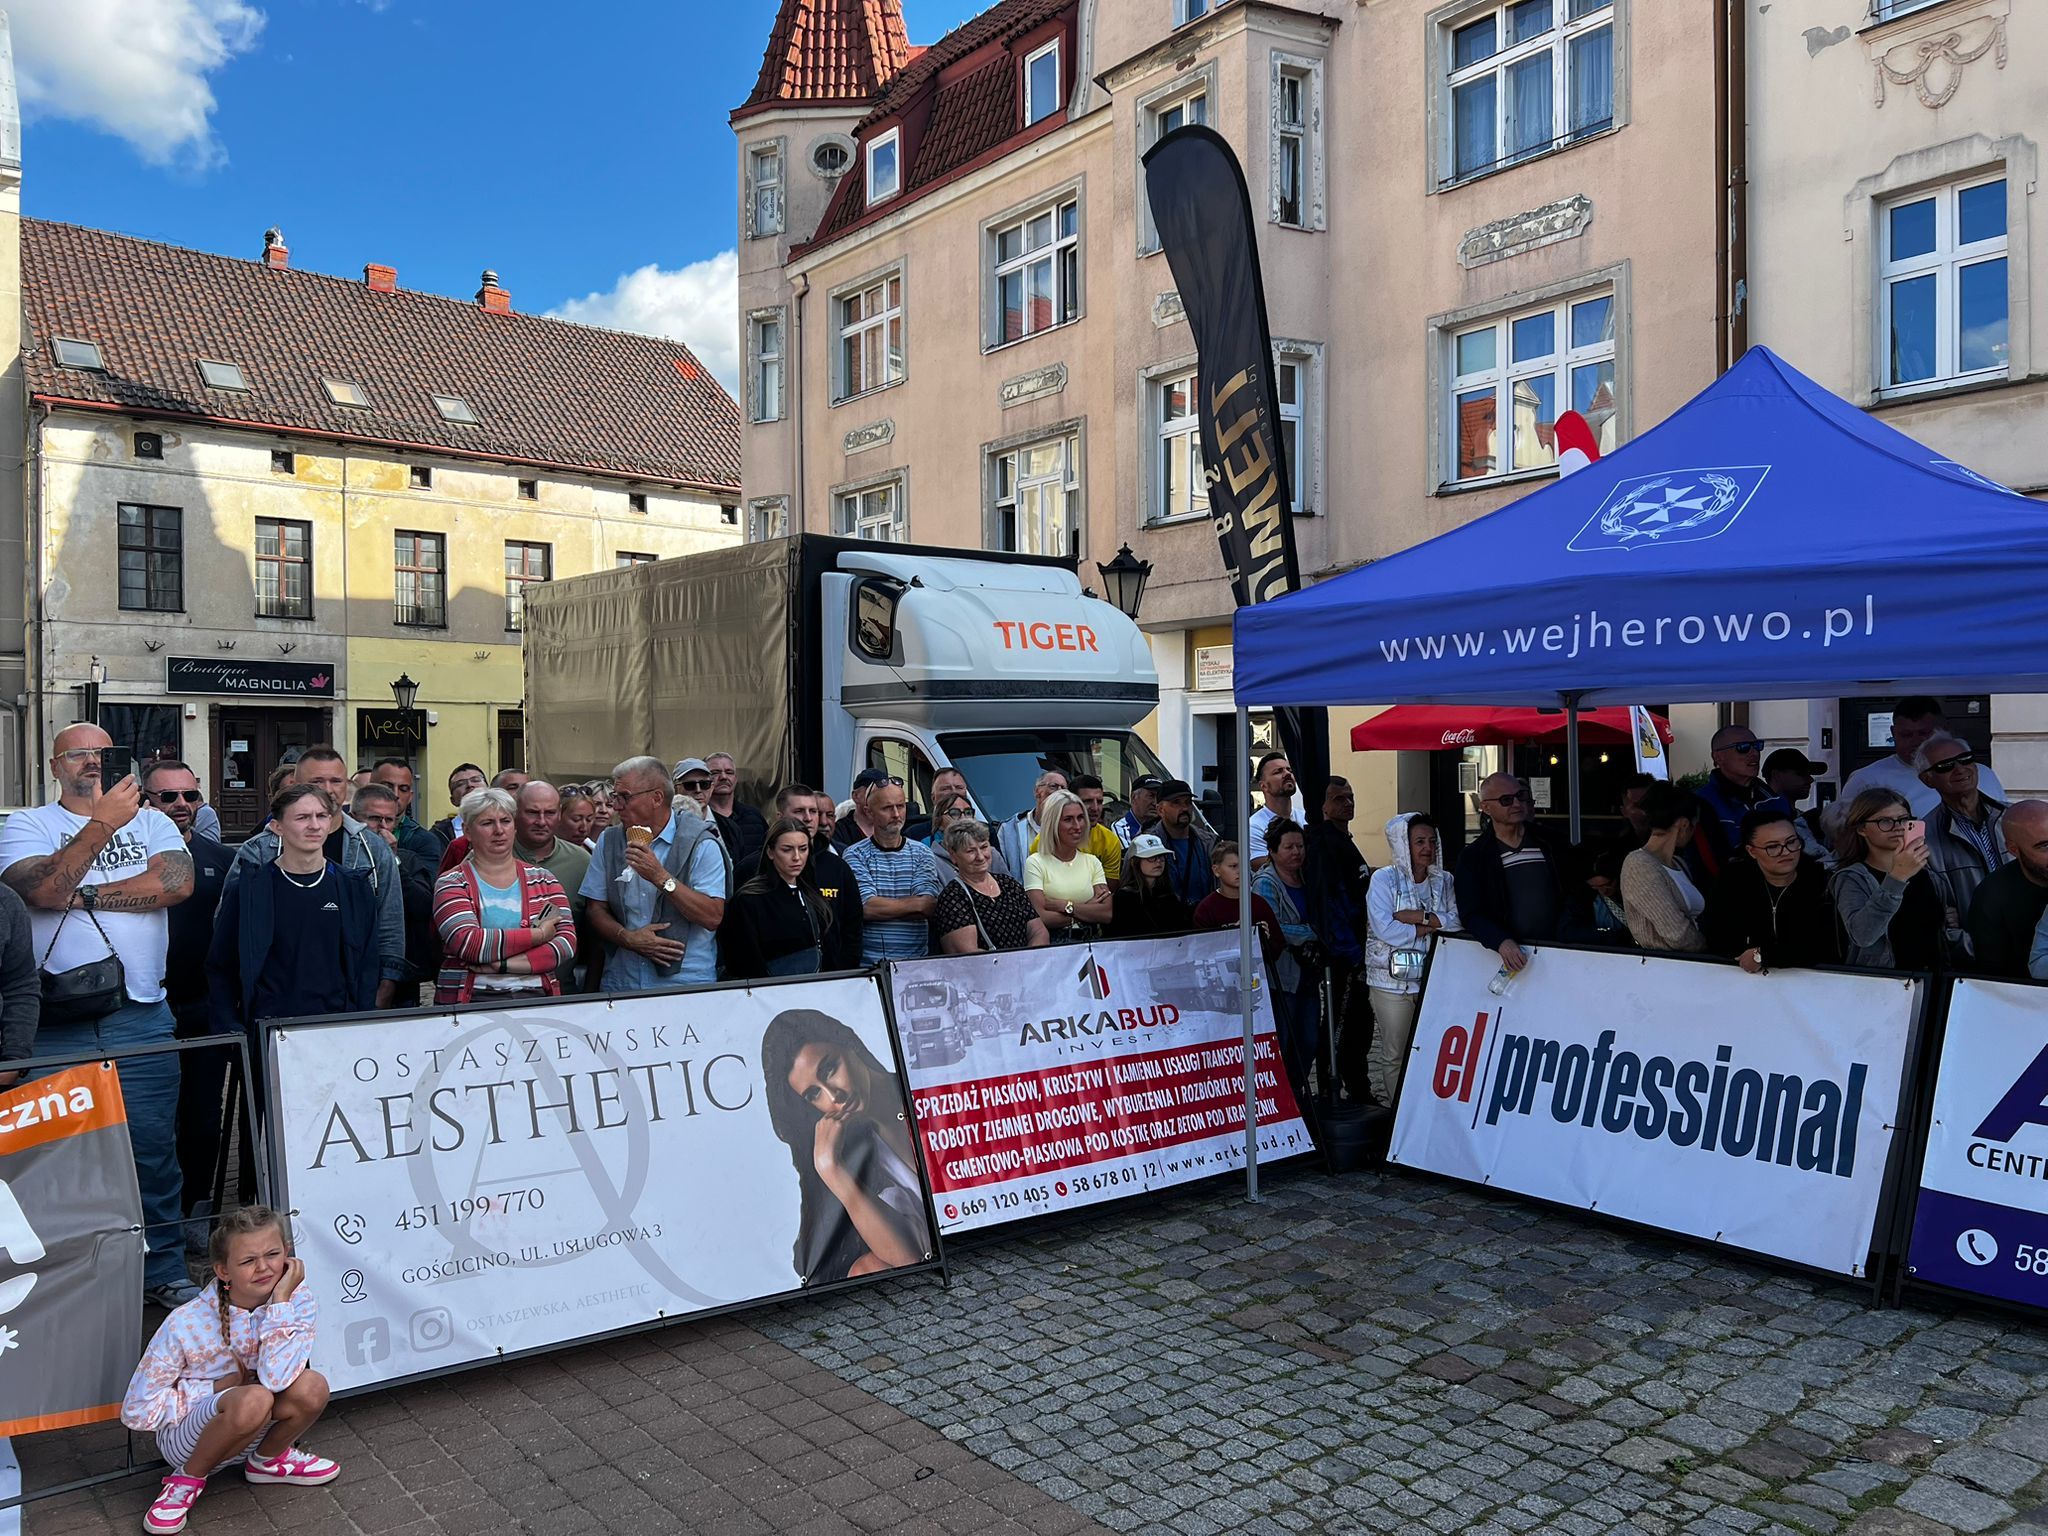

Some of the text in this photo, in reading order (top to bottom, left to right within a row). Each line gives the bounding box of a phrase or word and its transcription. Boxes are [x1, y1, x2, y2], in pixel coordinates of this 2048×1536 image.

[993, 621, 1099, 652] TIGER
[1379, 594, 1874, 662] www.wejherowo.pl
[172, 661, 249, 684] Boutique
[225, 678, 307, 691] MAGNOLIA
[94, 890, 158, 909] Viviana
[1019, 1003, 1180, 1046] ARKABUD
[1057, 1033, 1153, 1056] INVEST
[353, 1023, 703, 1083] OSTASZEWSKA
[915, 1040, 1276, 1120] SPRZEDAŻ PIASKÓW, KRUSZYW I KAMIENIA USŁUGI TRANSPOOWE,
[1431, 1011, 1489, 1104] el
[1485, 1030, 1869, 1179] professional
[306, 1053, 753, 1170] AESTHETIC
[927, 1123, 980, 1152] ROBOTY
[1035, 1102, 1103, 1132] DROGOWE,
[1103, 1088, 1175, 1118] WYBURZENIA
[1174, 1086, 1181, 1105] I
[1181, 1075, 1232, 1104] ROZBIÓRKI
[946, 1137, 1084, 1181] CEMENTOWO-PIASKOWA
[1084, 1131, 1110, 1154] POD
[1111, 1123, 1152, 1148] KOSTKĘ
[1150, 1118, 1177, 1140] ORAZ
[1177, 1111, 1206, 1135] BETON
[1206, 1108, 1226, 1128] POD
[1966, 1142, 2048, 1181] CENT
[395, 1187, 545, 1232] 451 199 770
[961, 1198, 988, 1216] 669
[992, 1191, 1020, 1210] 120
[1023, 1185, 1050, 1203] 405
[1072, 1177, 1090, 1194] 58
[1093, 1171, 1119, 1190] 678
[1122, 1166, 1137, 1182] 01
[1143, 1162, 1157, 1179] 12
[401, 1223, 663, 1285] GOŚCICINO, UL. USŁUGOWA 3
[2014, 1244, 2048, 1276] 58
[466, 1282, 651, 1332] OSTASZEWSKA AESTHETIC
